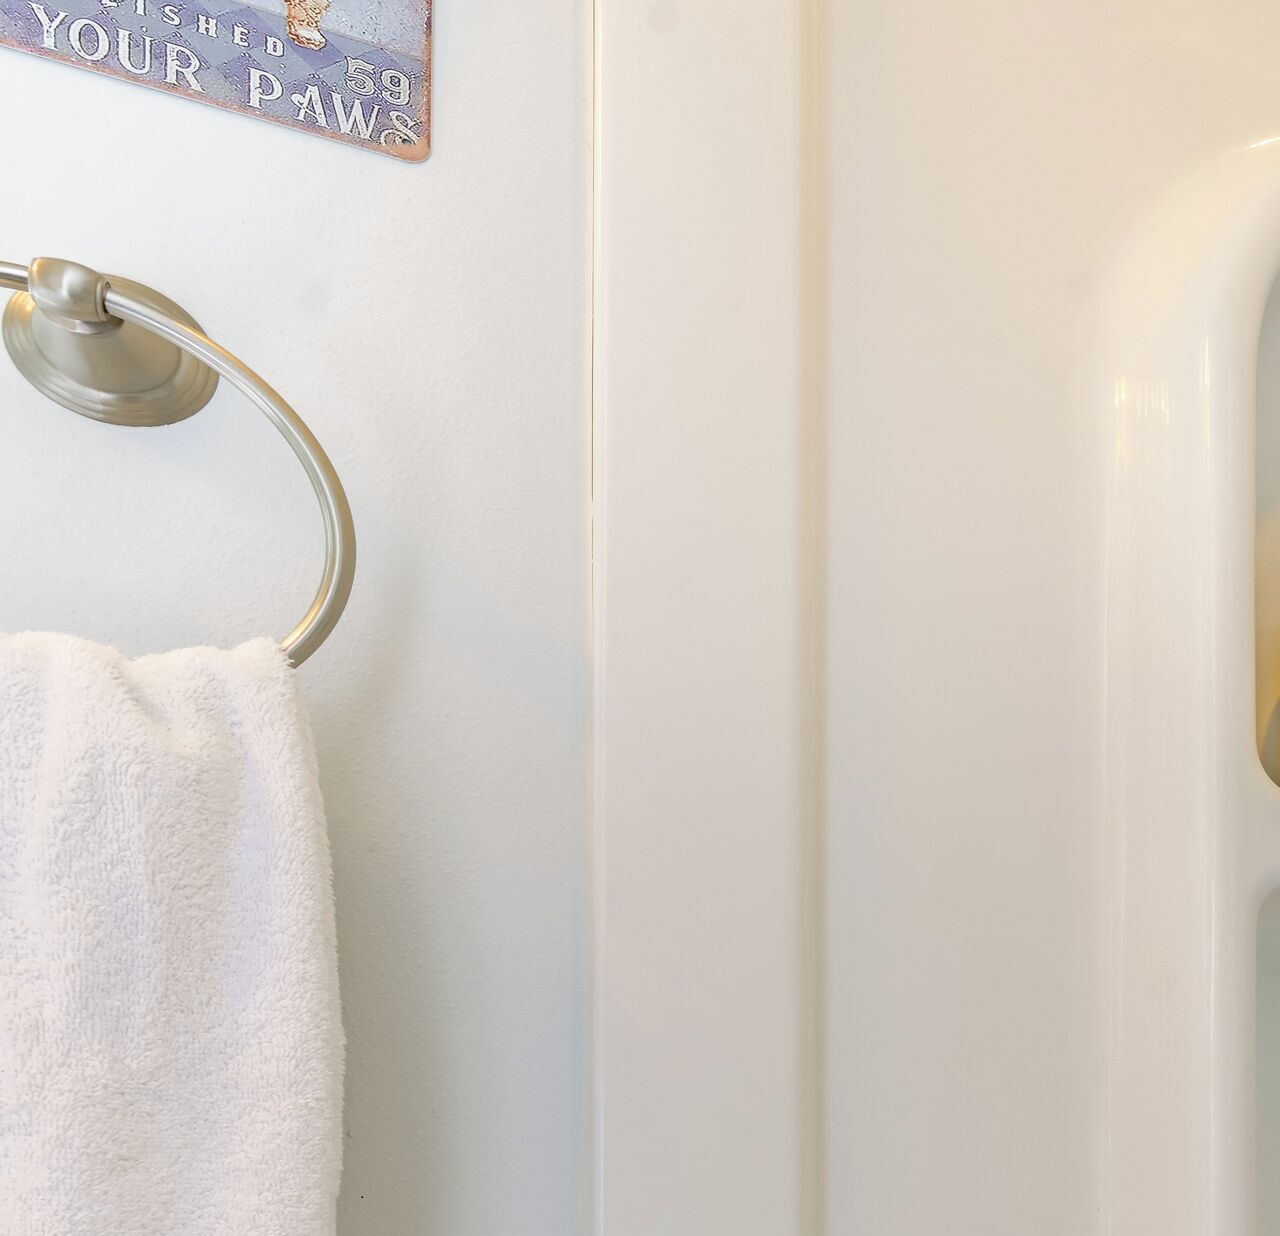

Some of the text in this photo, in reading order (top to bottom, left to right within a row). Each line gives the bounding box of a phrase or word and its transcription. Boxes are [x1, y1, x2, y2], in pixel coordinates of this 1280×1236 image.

[27, 2, 422, 146] YOUR PAWS
[344, 55, 413, 107] 59
